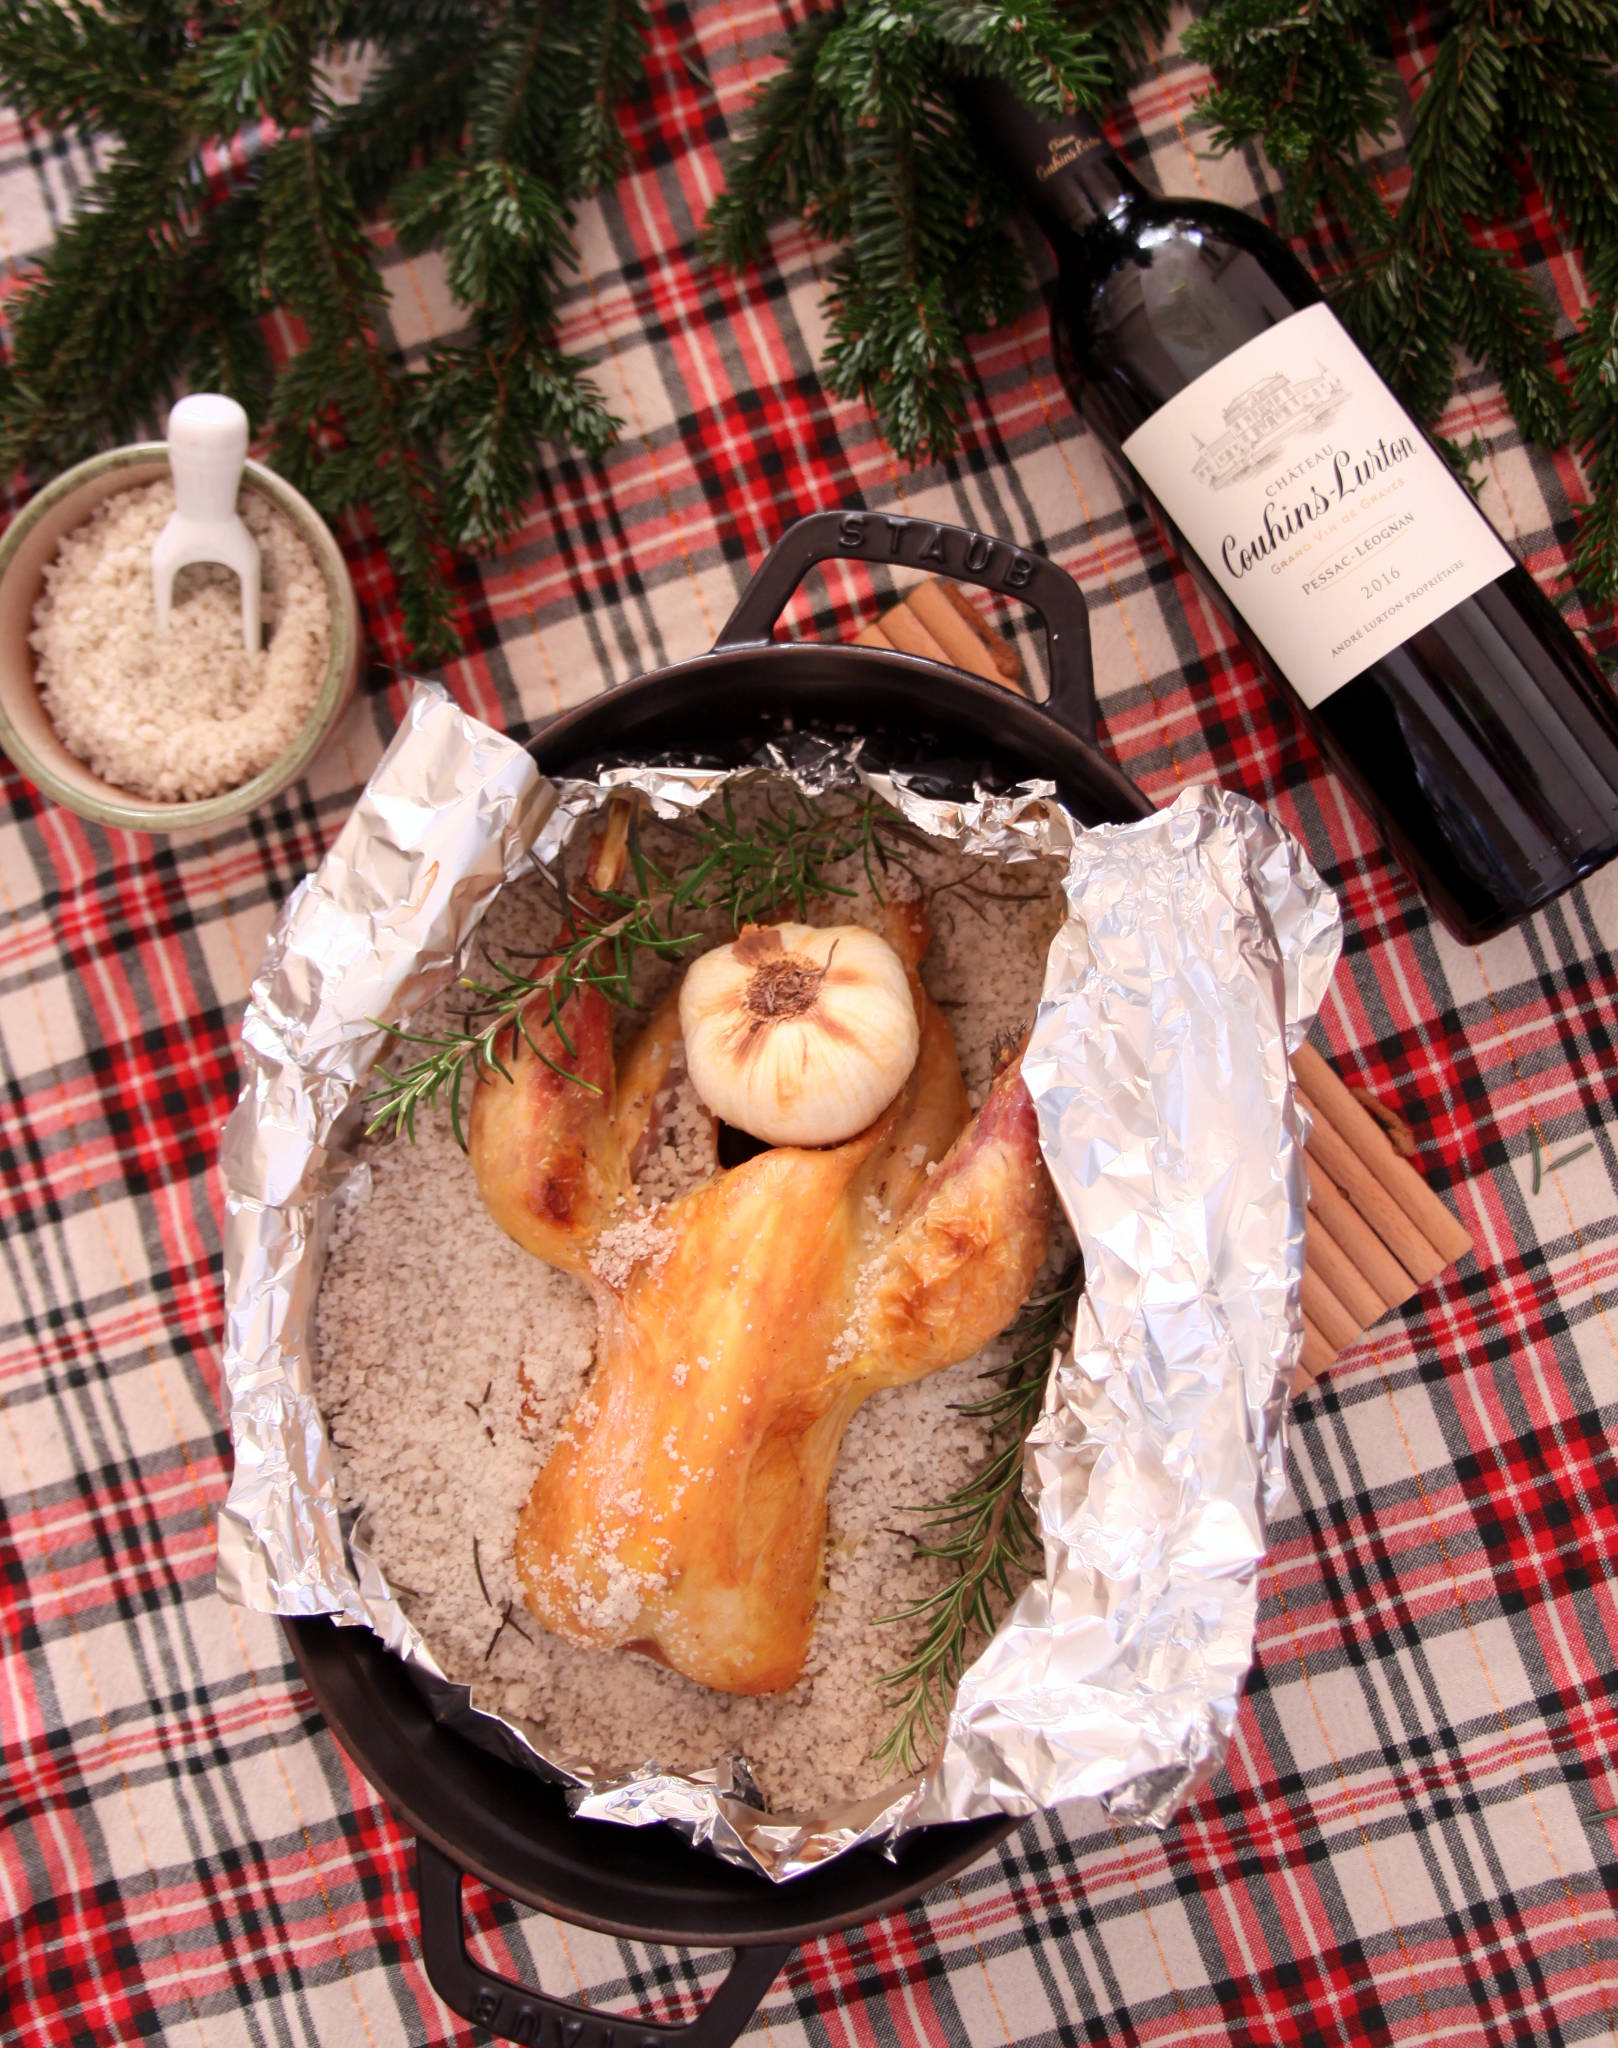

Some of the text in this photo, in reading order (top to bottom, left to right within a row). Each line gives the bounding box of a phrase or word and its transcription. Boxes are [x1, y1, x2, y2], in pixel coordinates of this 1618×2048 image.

[1265, 444, 1335, 497] CHÂTEAU
[838, 514, 1034, 587] STAUB
[1331, 559, 1465, 657] ANDRÉ LURTON PROPRIÉTAIRE
[1360, 567, 1401, 599] 2016
